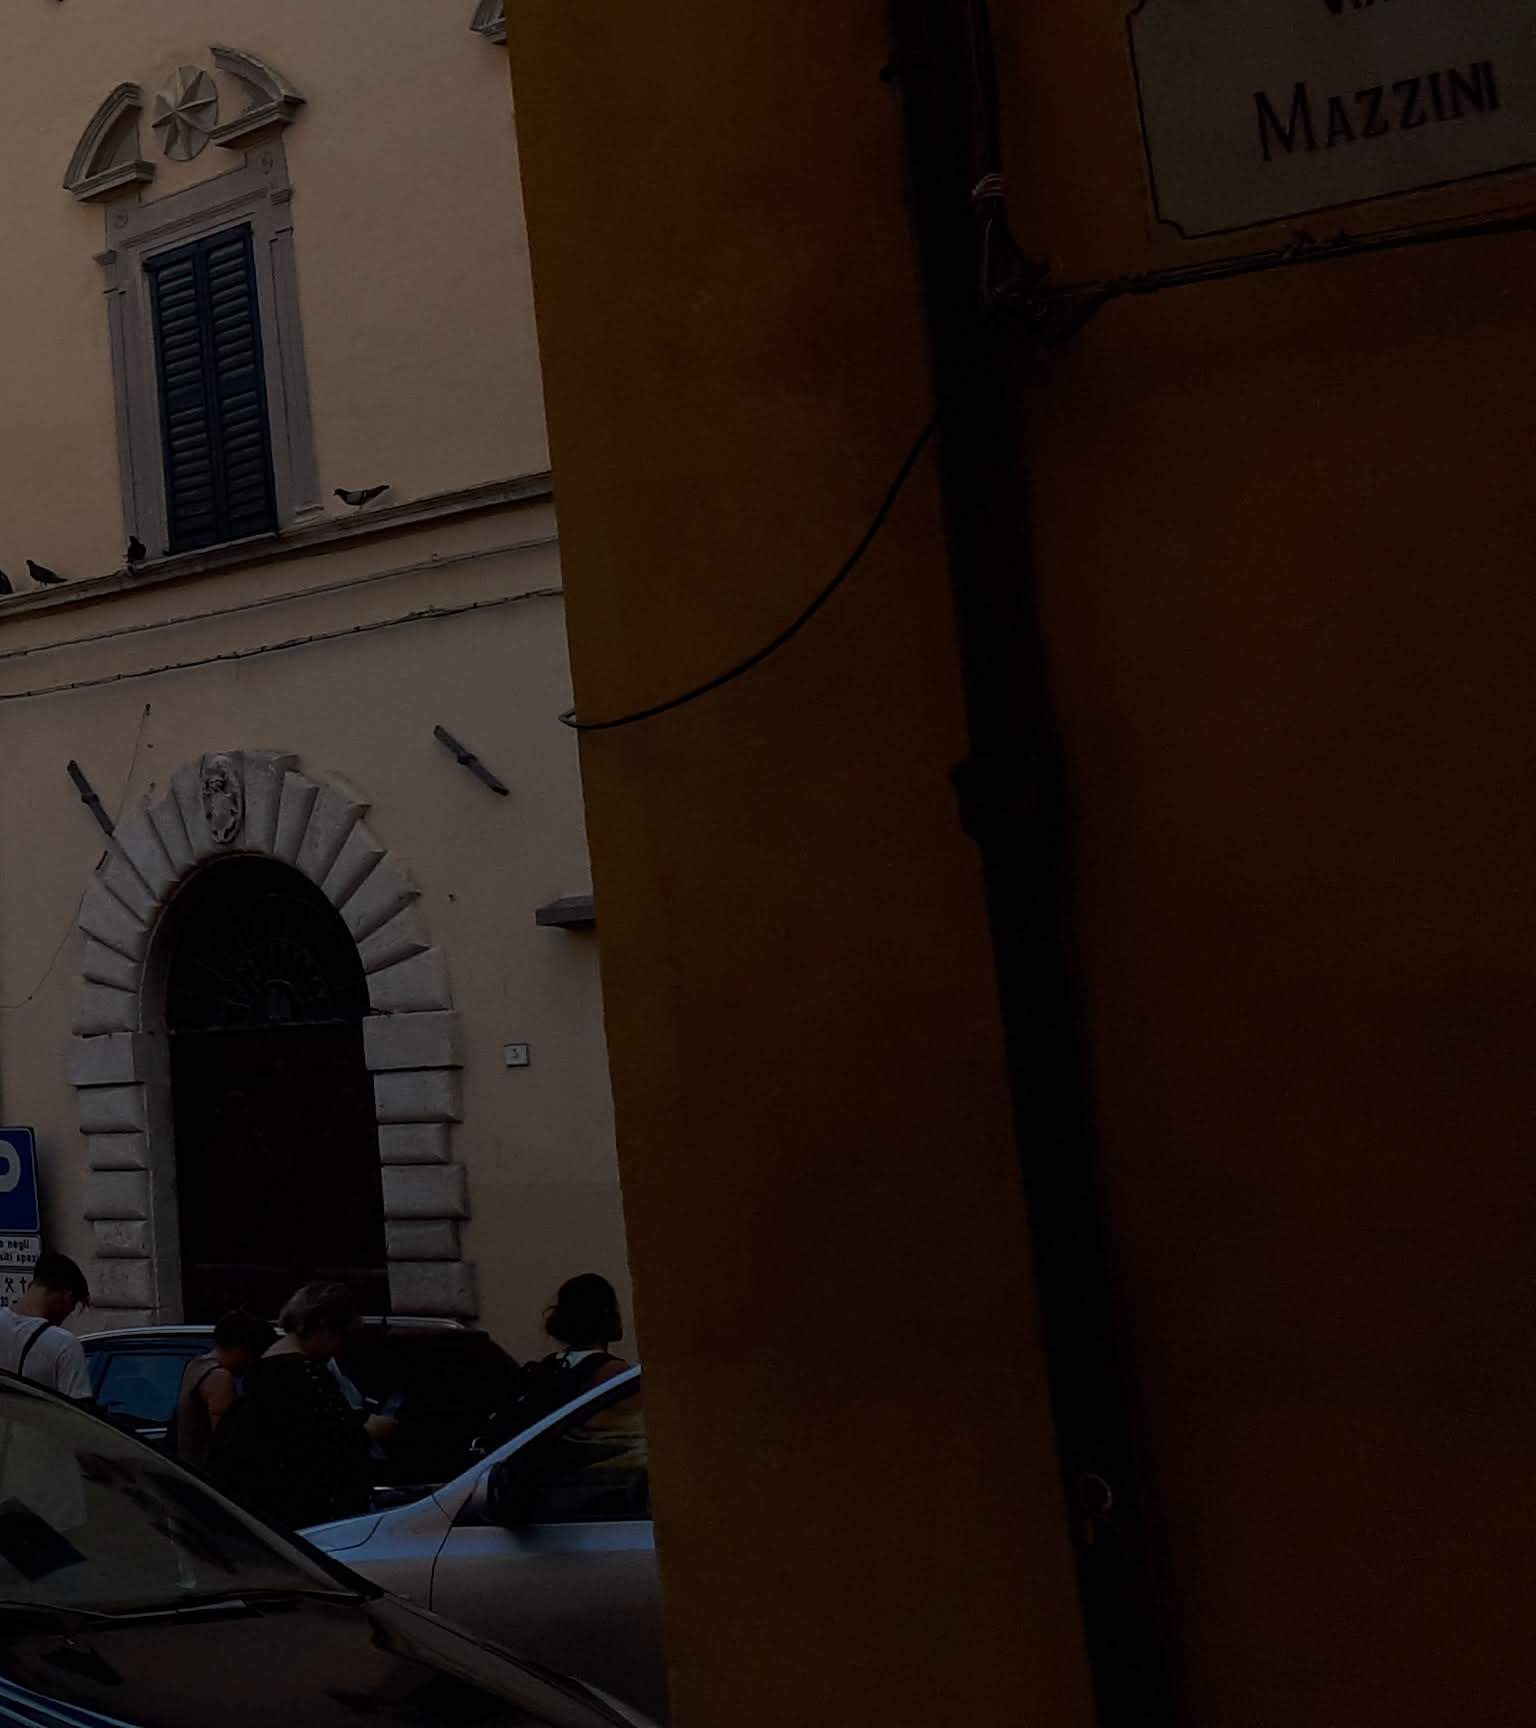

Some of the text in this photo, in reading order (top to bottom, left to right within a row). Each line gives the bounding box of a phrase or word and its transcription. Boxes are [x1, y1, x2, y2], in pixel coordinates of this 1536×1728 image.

[1253, 60, 1501, 161] MAZZINI
[7, 1239, 30, 1251] negli
[16, 1253, 37, 1264] spaz
